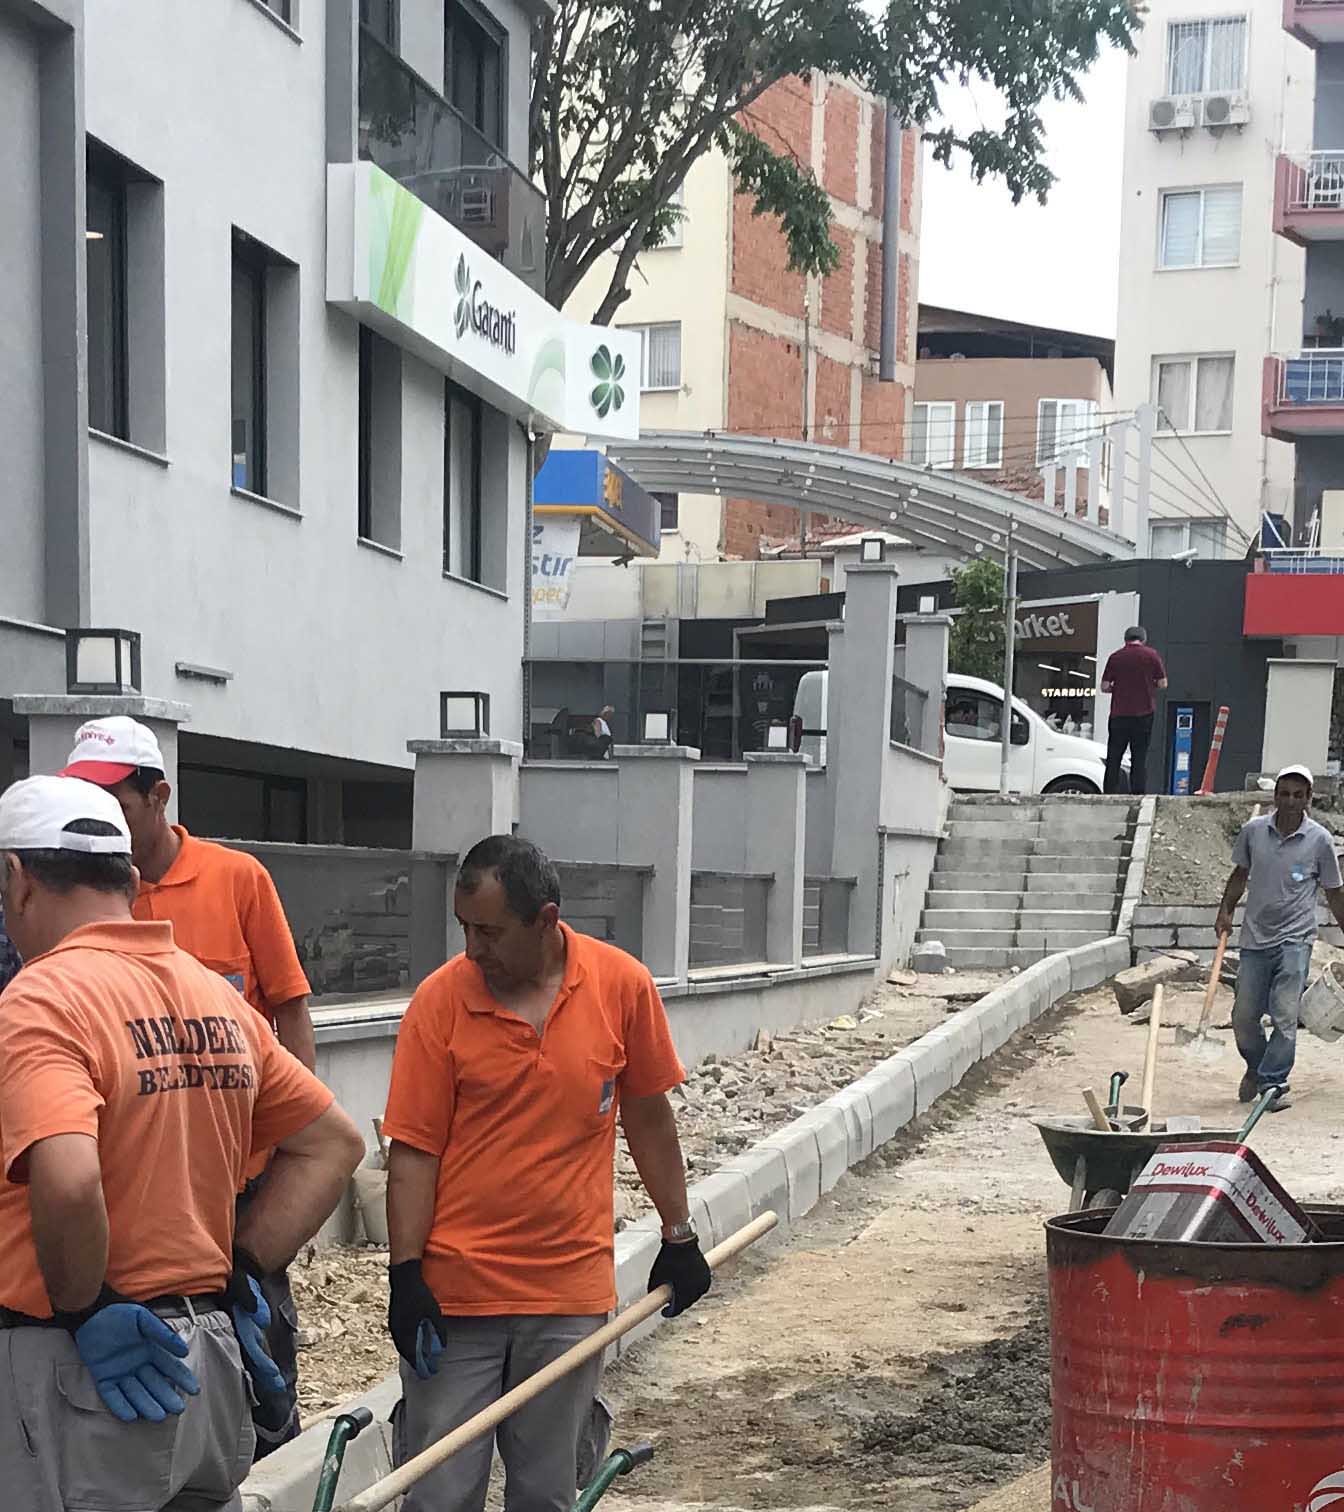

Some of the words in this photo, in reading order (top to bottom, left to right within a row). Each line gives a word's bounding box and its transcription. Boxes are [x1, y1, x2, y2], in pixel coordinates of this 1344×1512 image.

[472, 279, 516, 355] Garanti
[1002, 612, 1075, 640] arket
[1151, 1162, 1209, 1178] Dewilux
[1246, 1191, 1286, 1243] Dewilux
